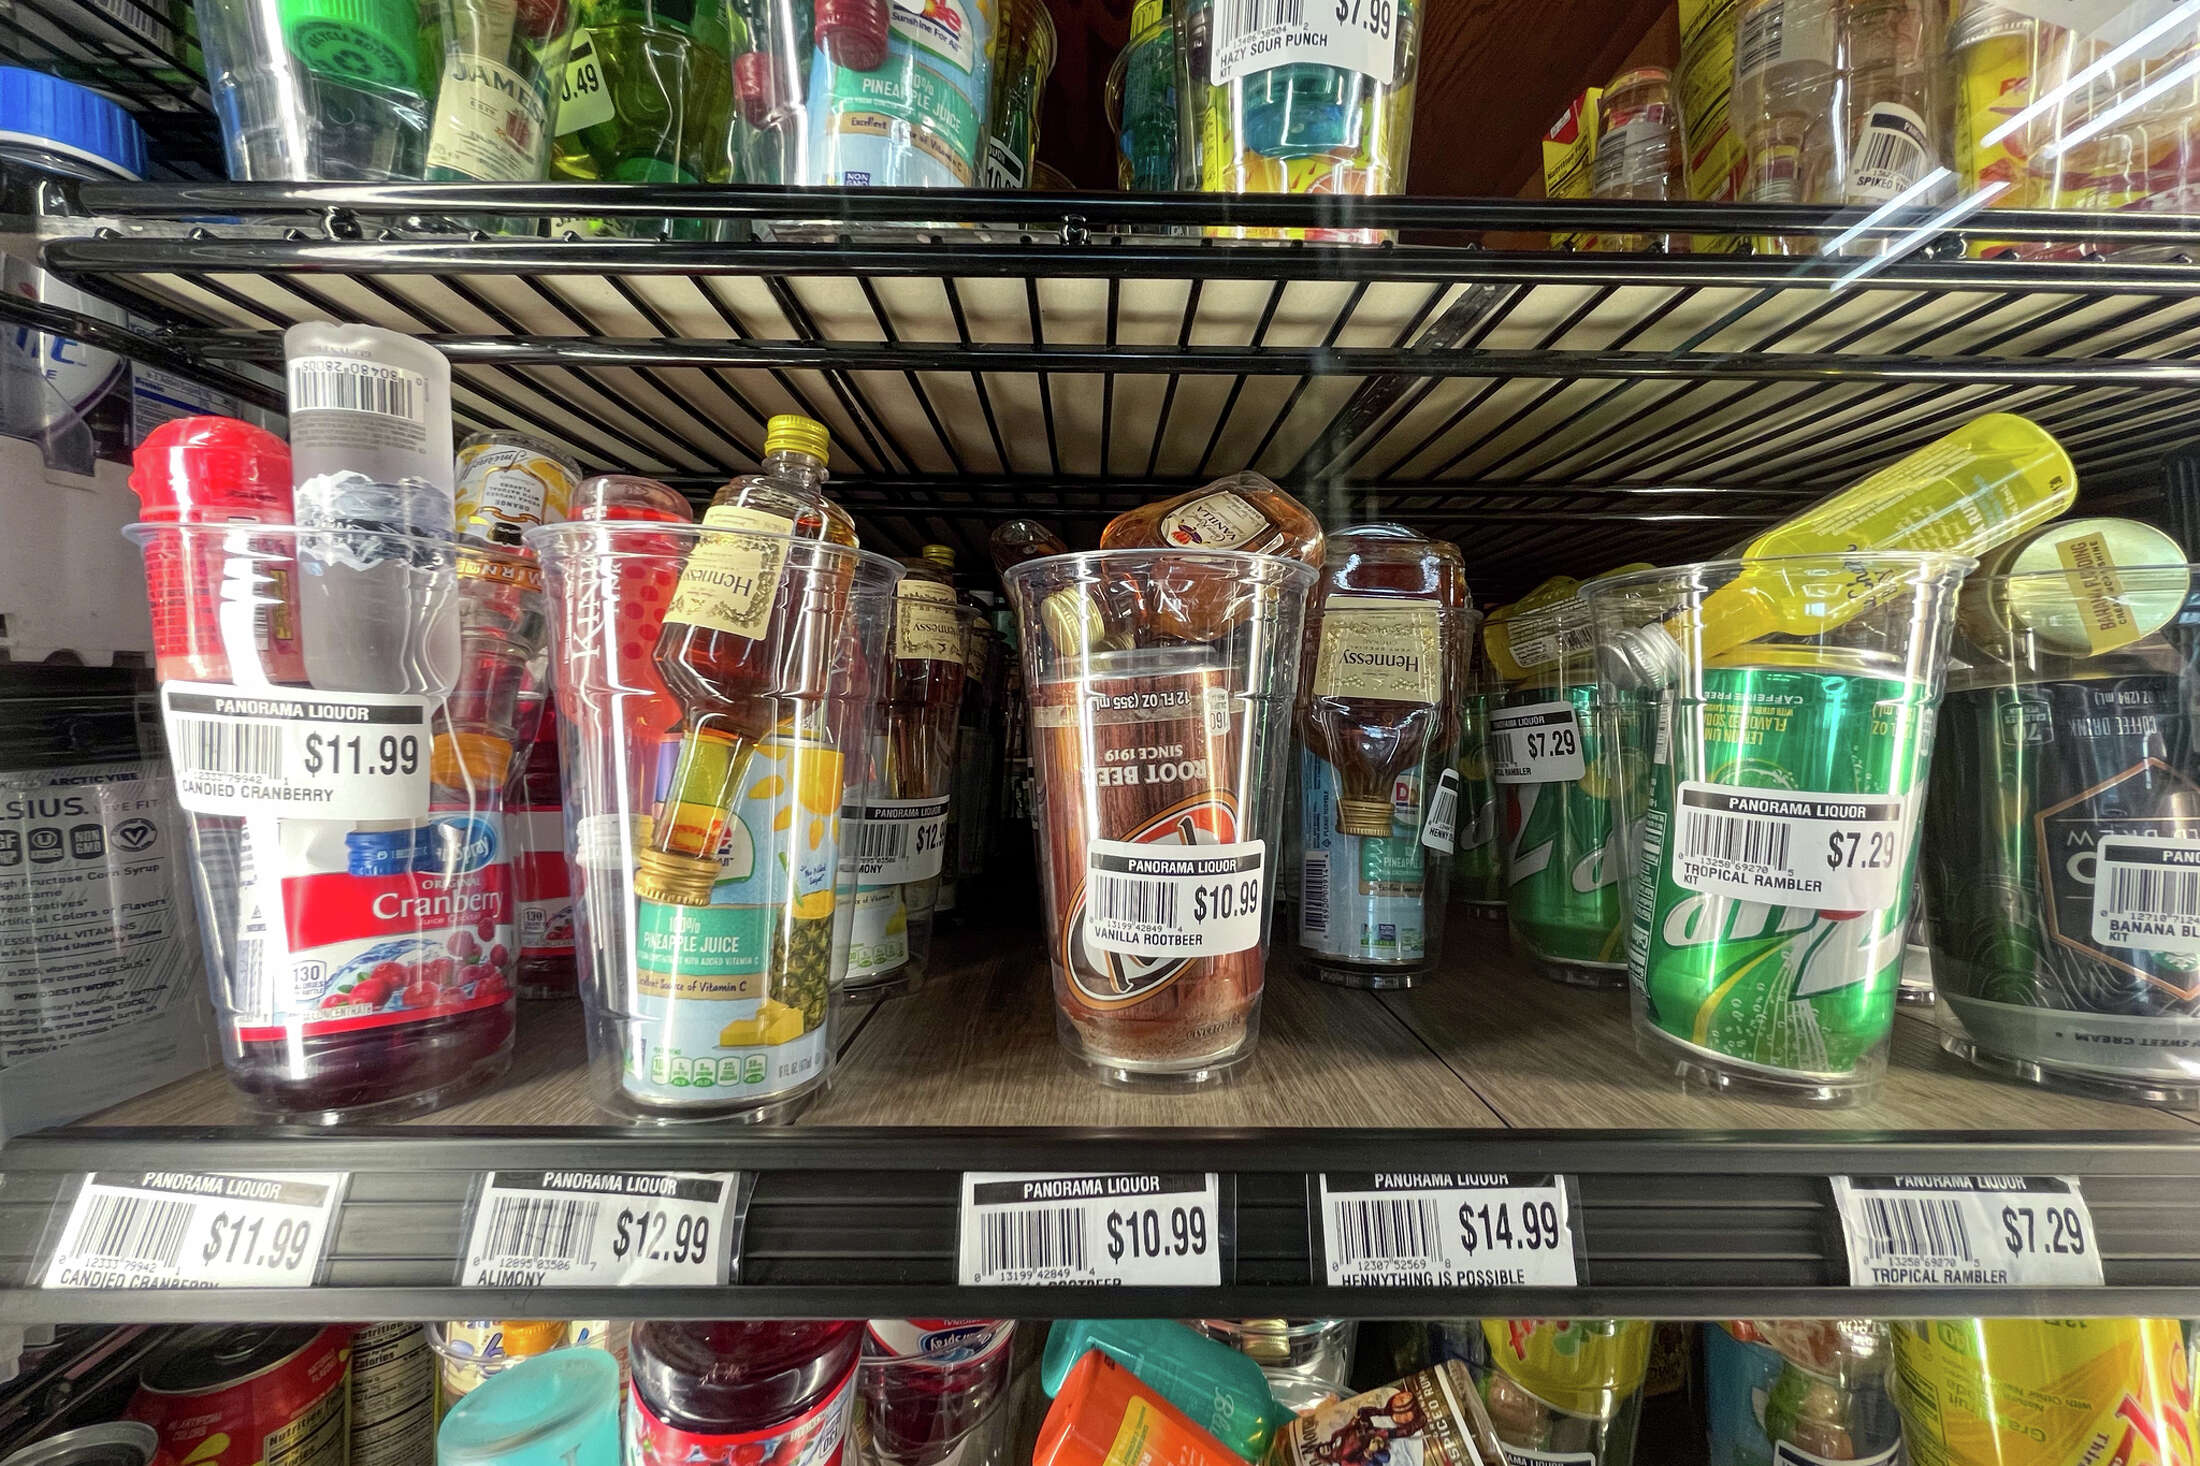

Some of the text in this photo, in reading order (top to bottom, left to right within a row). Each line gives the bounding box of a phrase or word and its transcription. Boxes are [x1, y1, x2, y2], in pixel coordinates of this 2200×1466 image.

[1336, 0, 1391, 40] $7.99
[1220, 33, 1328, 67] HAZY SOUR PUNCH
[1220, 66, 1231, 79] KIT
[932, 103, 961, 134] JUICE
[1856, 175, 1893, 189] SPIKED
[494, 499, 530, 512] ORANGE
[1197, 506, 1237, 541] VANILLA
[1339, 649, 1419, 673] Hennessy
[1113, 695, 1139, 710] (355
[1141, 693, 1159, 707] OZ
[1160, 692, 1177, 706] FL
[1177, 690, 1191, 705] 12
[1703, 690, 1732, 701] FREE
[216, 698, 370, 722] PANORAMA LIQUOR
[1518, 716, 1545, 727] LIQUOR
[1872, 721, 1888, 735] OZ
[2115, 715, 2158, 736] COFFEE
[304, 729, 419, 778] $11.99
[1104, 743, 1184, 762] SINCE 1919
[1527, 729, 1576, 761] $7.29
[51, 772, 139, 787] ARCTIC VIBE
[227, 771, 262, 784] 79942
[1086, 758, 1208, 787] ROOT BEE
[182, 779, 334, 802] CANDIED CRANBERRY
[874, 807, 920, 819] PANORAMA
[1728, 797, 1867, 819] PANORAMA LIQUOR
[1826, 829, 1896, 871] $7.29
[123, 863, 160, 878] Syrup
[1128, 858, 1237, 874] PANORAMA LIQUOR
[1700, 858, 1794, 876] 13258 69270 5
[1683, 875, 1699, 887] KIT
[1684, 862, 1823, 893] TROPICAL RAMBLER
[372, 889, 503, 920] Cranberry
[1193, 879, 1259, 925] $10.99
[526, 910, 543, 922] 130
[1094, 926, 1203, 946] VANILLA ROOTBEER
[1107, 922, 1184, 933] 13199 42849 4
[2108, 931, 2129, 942] KIT
[2109, 919, 2176, 937] BANANA
[700, 936, 740, 953] JUICE
[292, 964, 321, 983] 130
[687, 980, 747, 993] of Vitamin C
[2074, 1033, 2135, 1046] CREAM
[142, 1172, 283, 1199] PANORAMA LIQUOR
[542, 1172, 678, 1196] PANORAMA LIQUOR
[1023, 1175, 1161, 1200] PANORAMA LIQUOR
[1375, 1173, 1509, 1189] PANORAMA LIQUOR
[1895, 1176, 2027, 1190] PANORAMA LIQUOR
[613, 1207, 710, 1264] $12.99
[1106, 1205, 1207, 1265] $10.99
[1458, 1200, 1560, 1257] $14.99
[2001, 1205, 2085, 1258] $7.29
[202, 1211, 312, 1270] $11.99
[590, 1262, 597, 1271] 7
[1394, 1260, 1427, 1271] 52569
[1444, 1259, 1452, 1269] 8
[1924, 1257, 1957, 1268] 69270
[1973, 1258, 1981, 1268] 5
[60, 1268, 125, 1288] CANDIED
[477, 1270, 546, 1287] ALIMONY
[1000, 1271, 1034, 1282] 13199
[1037, 1268, 1071, 1280] 42849
[1089, 1267, 1096, 1276] 4
[1342, 1269, 1526, 1287] HENNYTHING IS POSSIBLE
[1872, 1268, 2008, 1285] TROPICAL RAMBLER
